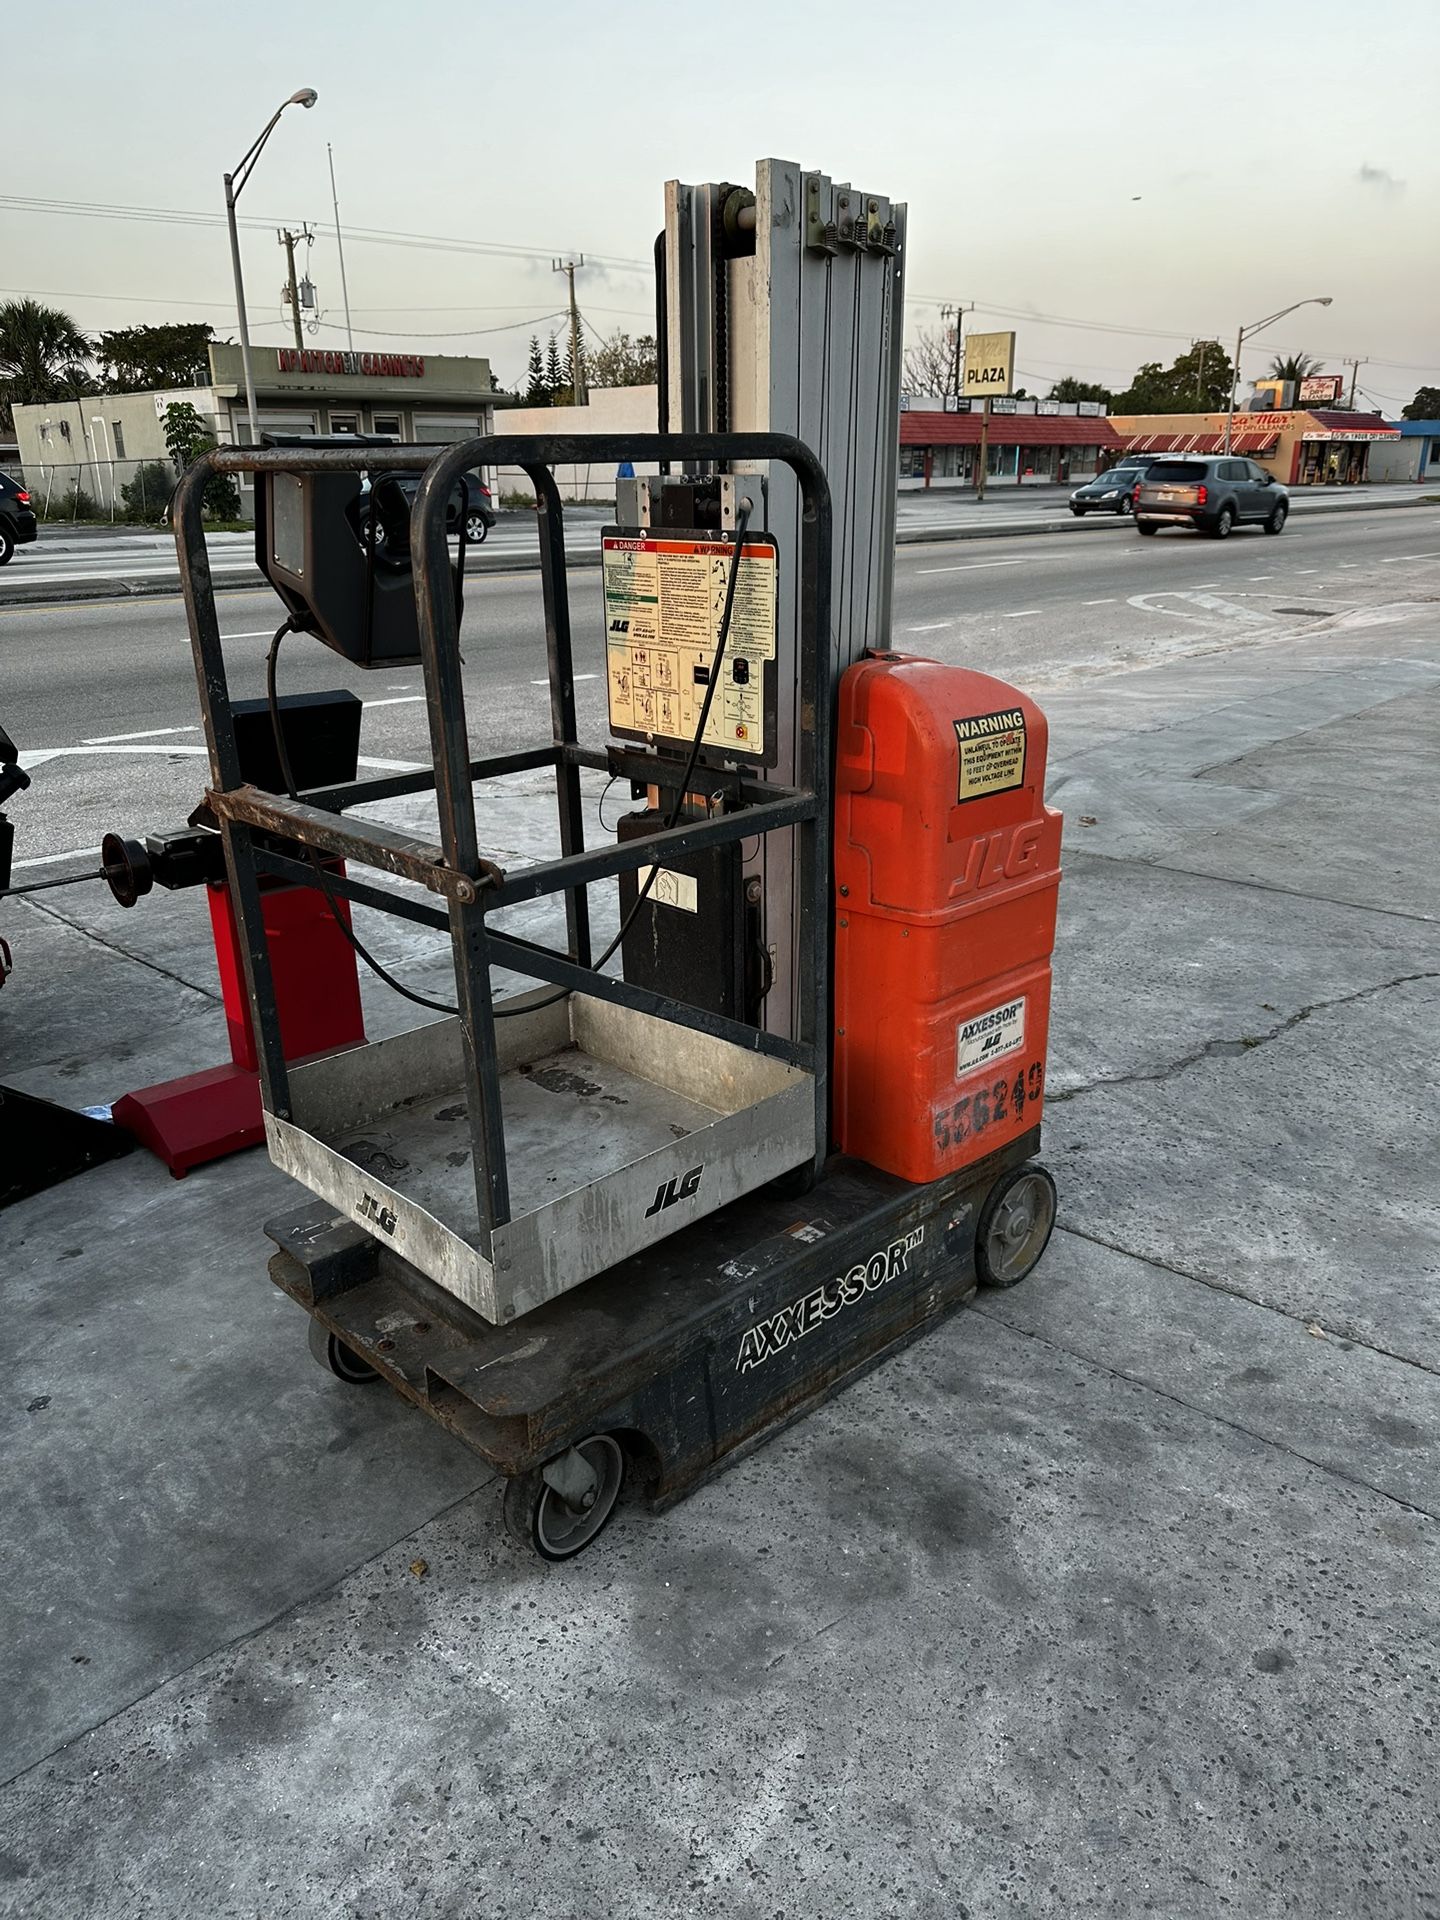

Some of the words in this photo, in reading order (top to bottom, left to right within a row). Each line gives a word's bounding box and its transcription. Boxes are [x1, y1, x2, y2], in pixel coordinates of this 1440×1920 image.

[298, 350, 361, 375] KITCHEN
[361, 352, 424, 377] CABINETS
[967, 368, 1005, 384] PLAZA
[1254, 414, 1289, 425] Mar
[618, 542, 646, 551] DANGER
[699, 545, 733, 555] WARNING
[609, 619, 629, 633] JLG
[956, 712, 1024, 738] WARNING
[963, 757, 976, 766] THIS
[976, 750, 1005, 764] EQUIPMENT
[1005, 747, 1022, 756] WITHIN
[964, 743, 992, 755] UNLAWFUL
[992, 741, 1000, 749] TO
[973, 765, 985, 775] FEET
[993, 757, 1019, 770] OVERHEAD
[968, 776, 982, 786] HIGH
[982, 771, 1004, 782] VOLTAGE
[1003, 768, 1015, 777] LINE
[948, 818, 1045, 899] JLG
[980, 1031, 1003, 1053] JLG
[644, 1163, 704, 1220] JLG
[354, 1192, 399, 1238] JLG
